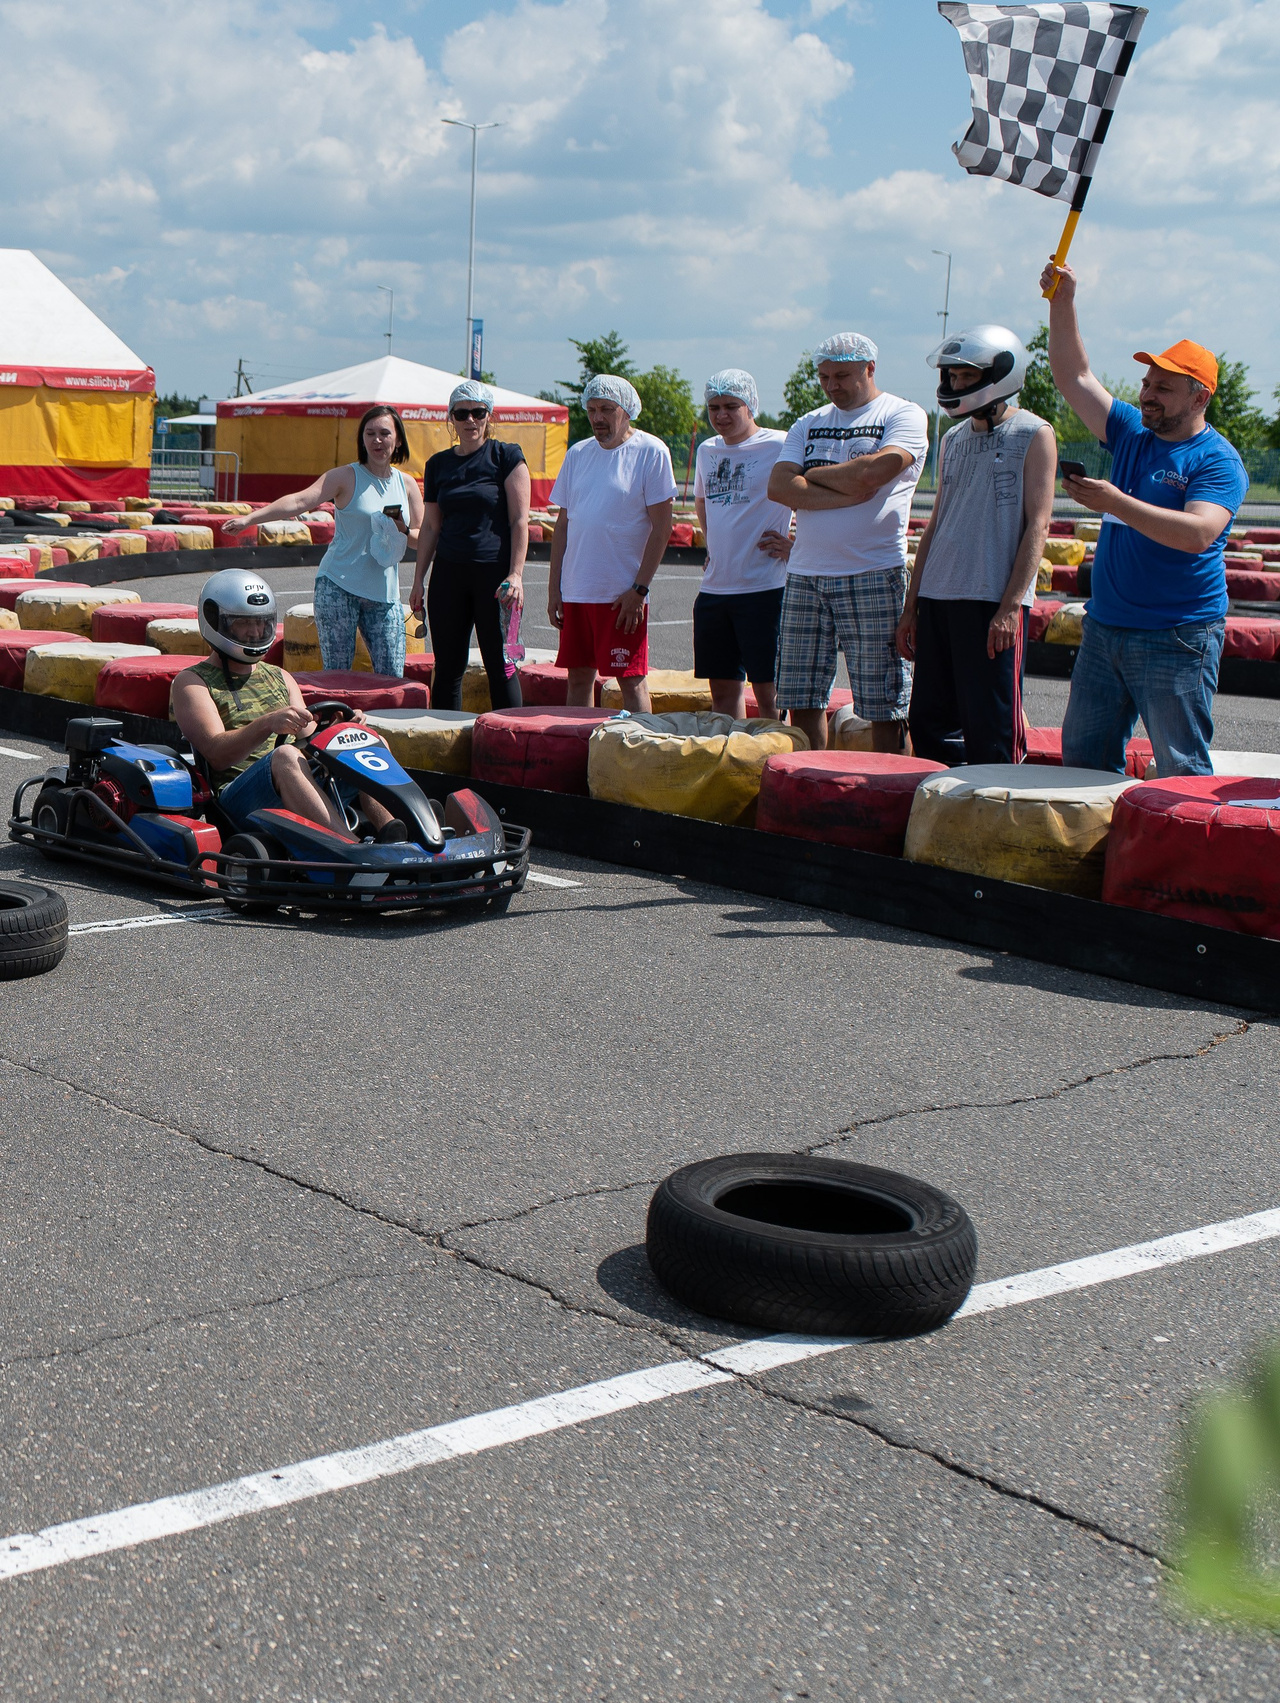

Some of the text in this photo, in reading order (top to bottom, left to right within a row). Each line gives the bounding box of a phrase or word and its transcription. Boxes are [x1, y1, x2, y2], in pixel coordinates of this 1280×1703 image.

[64, 374, 130, 390] www.silichy.by
[499, 411, 544, 423] www.silichy.by
[853, 427, 883, 437] DENIM
[354, 750, 390, 771] 6
